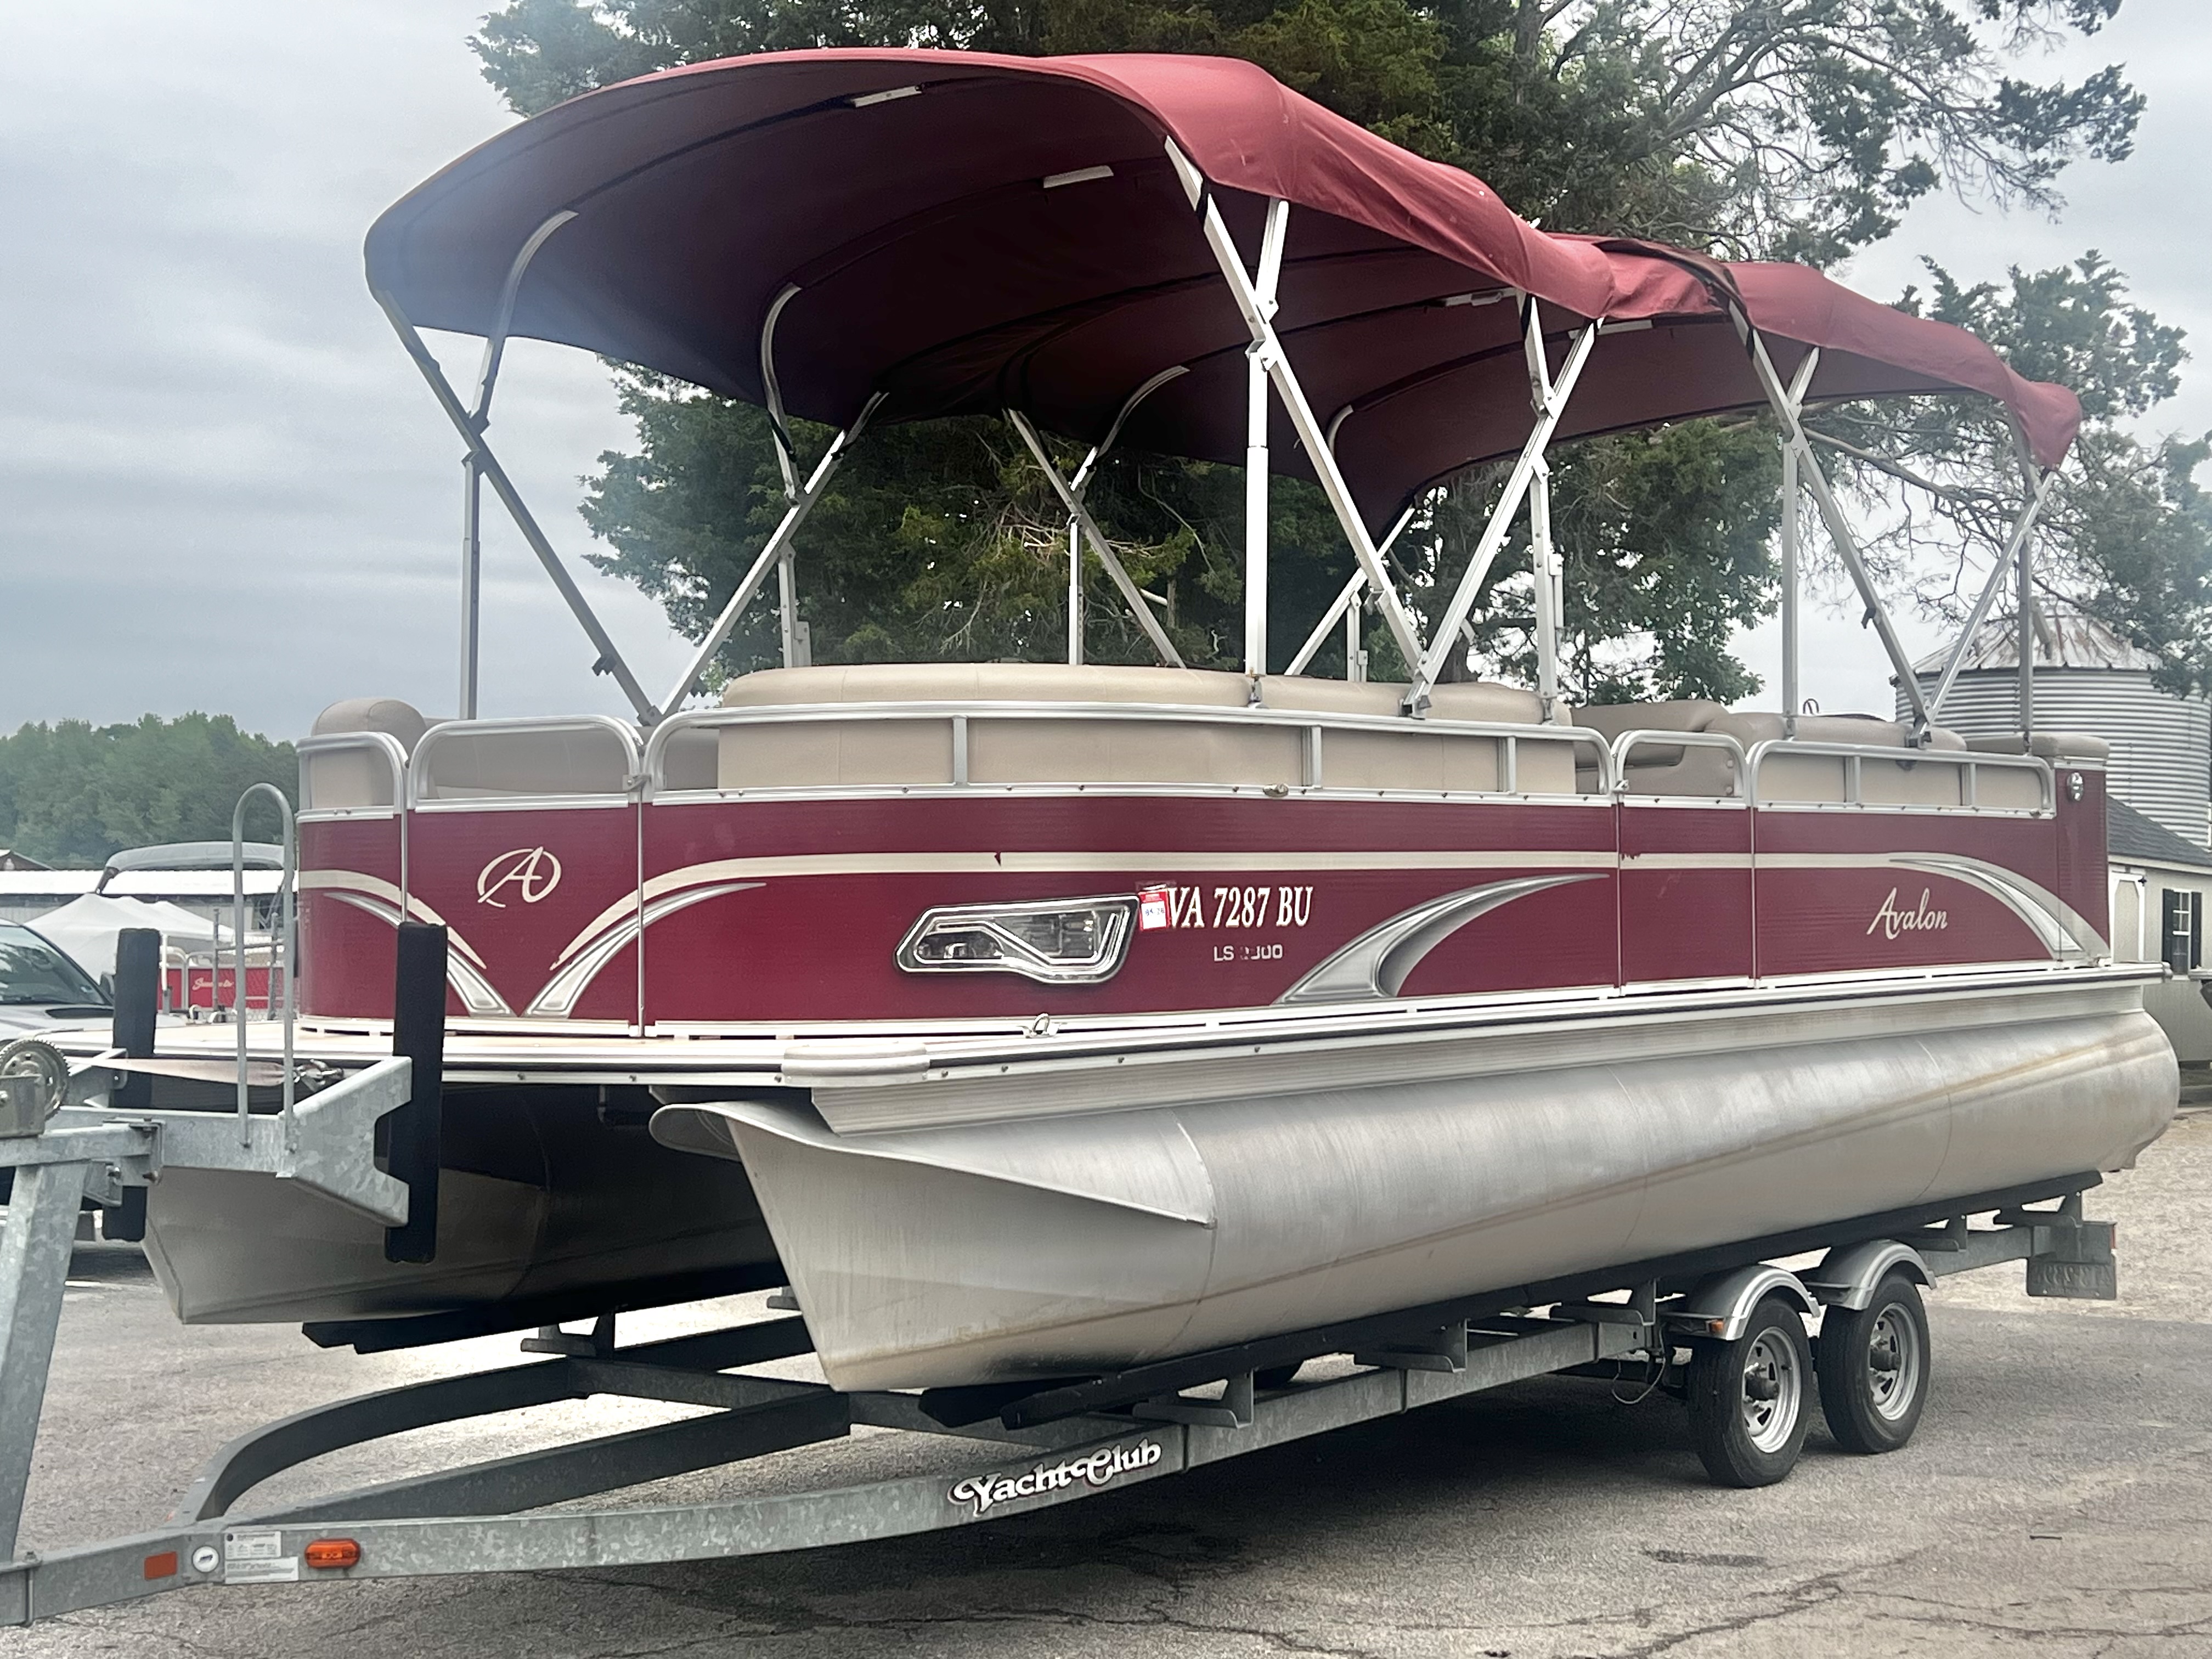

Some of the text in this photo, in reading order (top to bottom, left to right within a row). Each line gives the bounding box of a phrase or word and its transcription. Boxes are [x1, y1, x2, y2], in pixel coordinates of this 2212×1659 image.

[1167, 886, 1313, 928] VA 7287 BU
[1866, 887, 1948, 940] Avalon
[1214, 945, 1234, 961] LS
